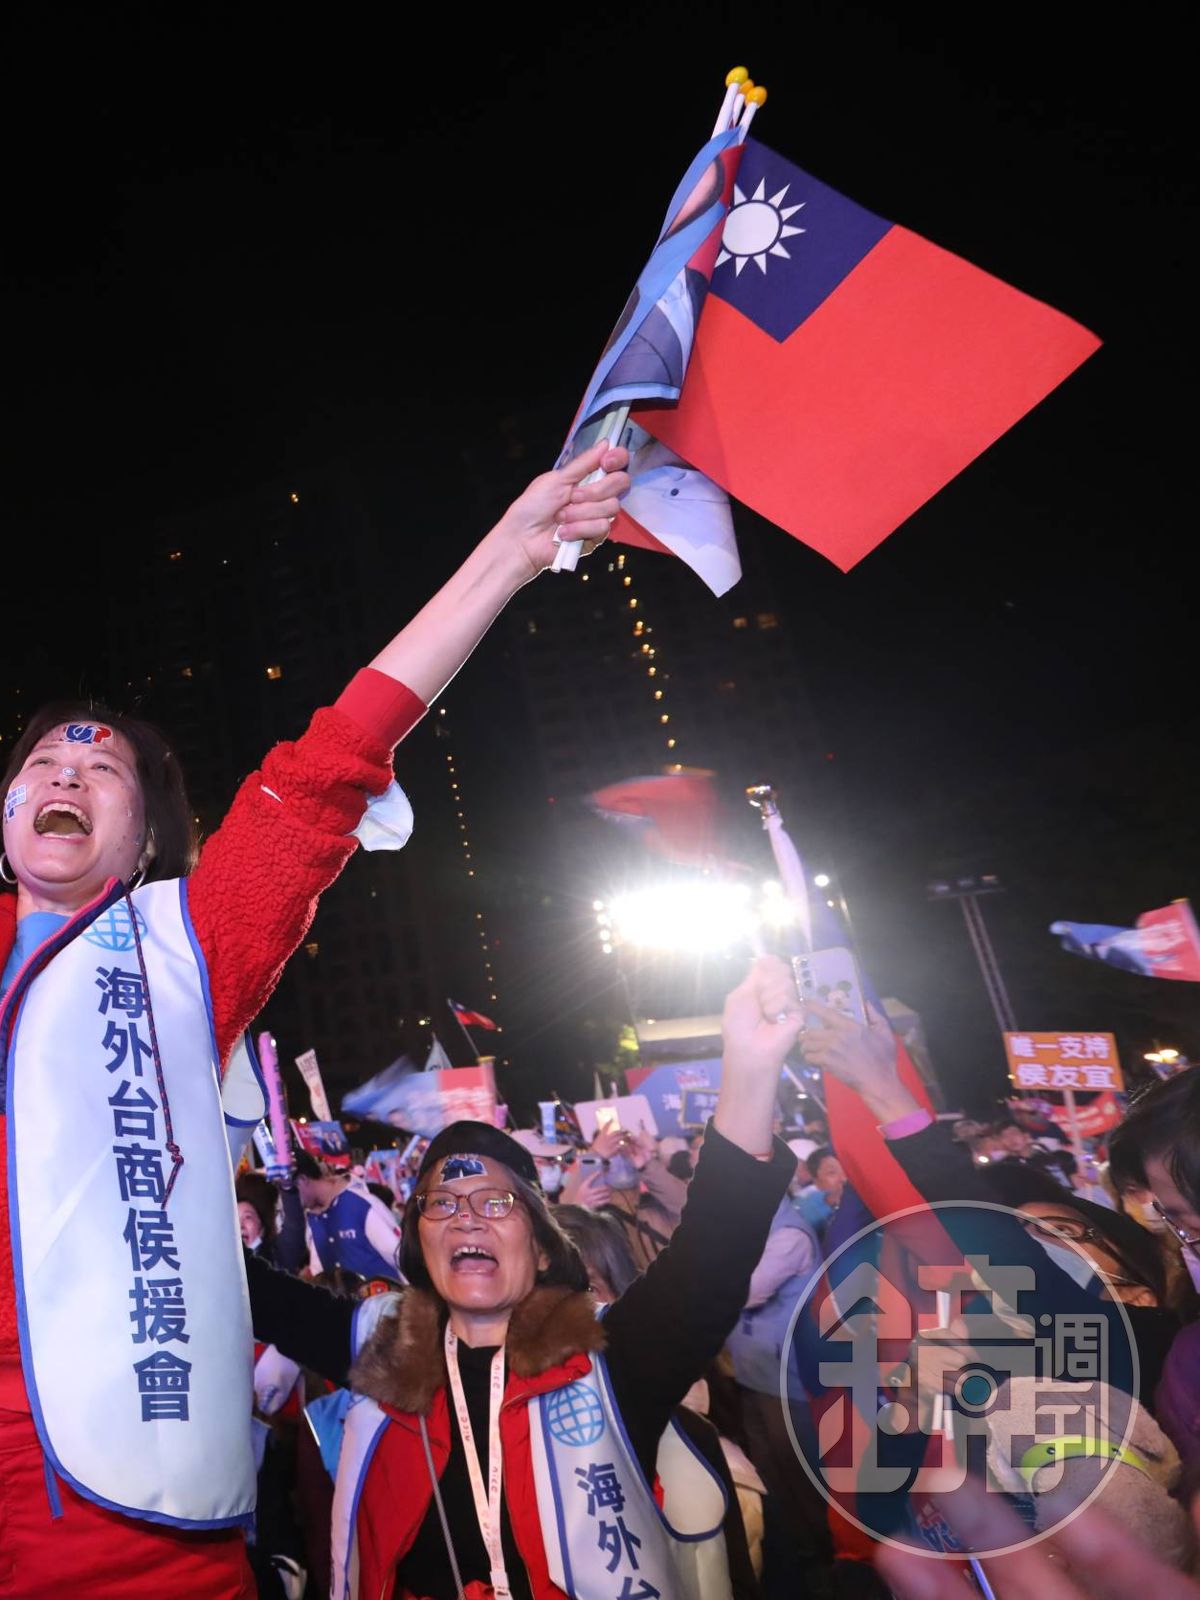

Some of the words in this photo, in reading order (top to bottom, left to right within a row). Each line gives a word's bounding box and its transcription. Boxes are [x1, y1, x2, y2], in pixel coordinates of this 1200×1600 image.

[1008, 1035, 1110, 1059] 唯一支持
[1016, 1063, 1117, 1089] 侯友宜
[94, 966, 193, 1423] 海外台商侯援會
